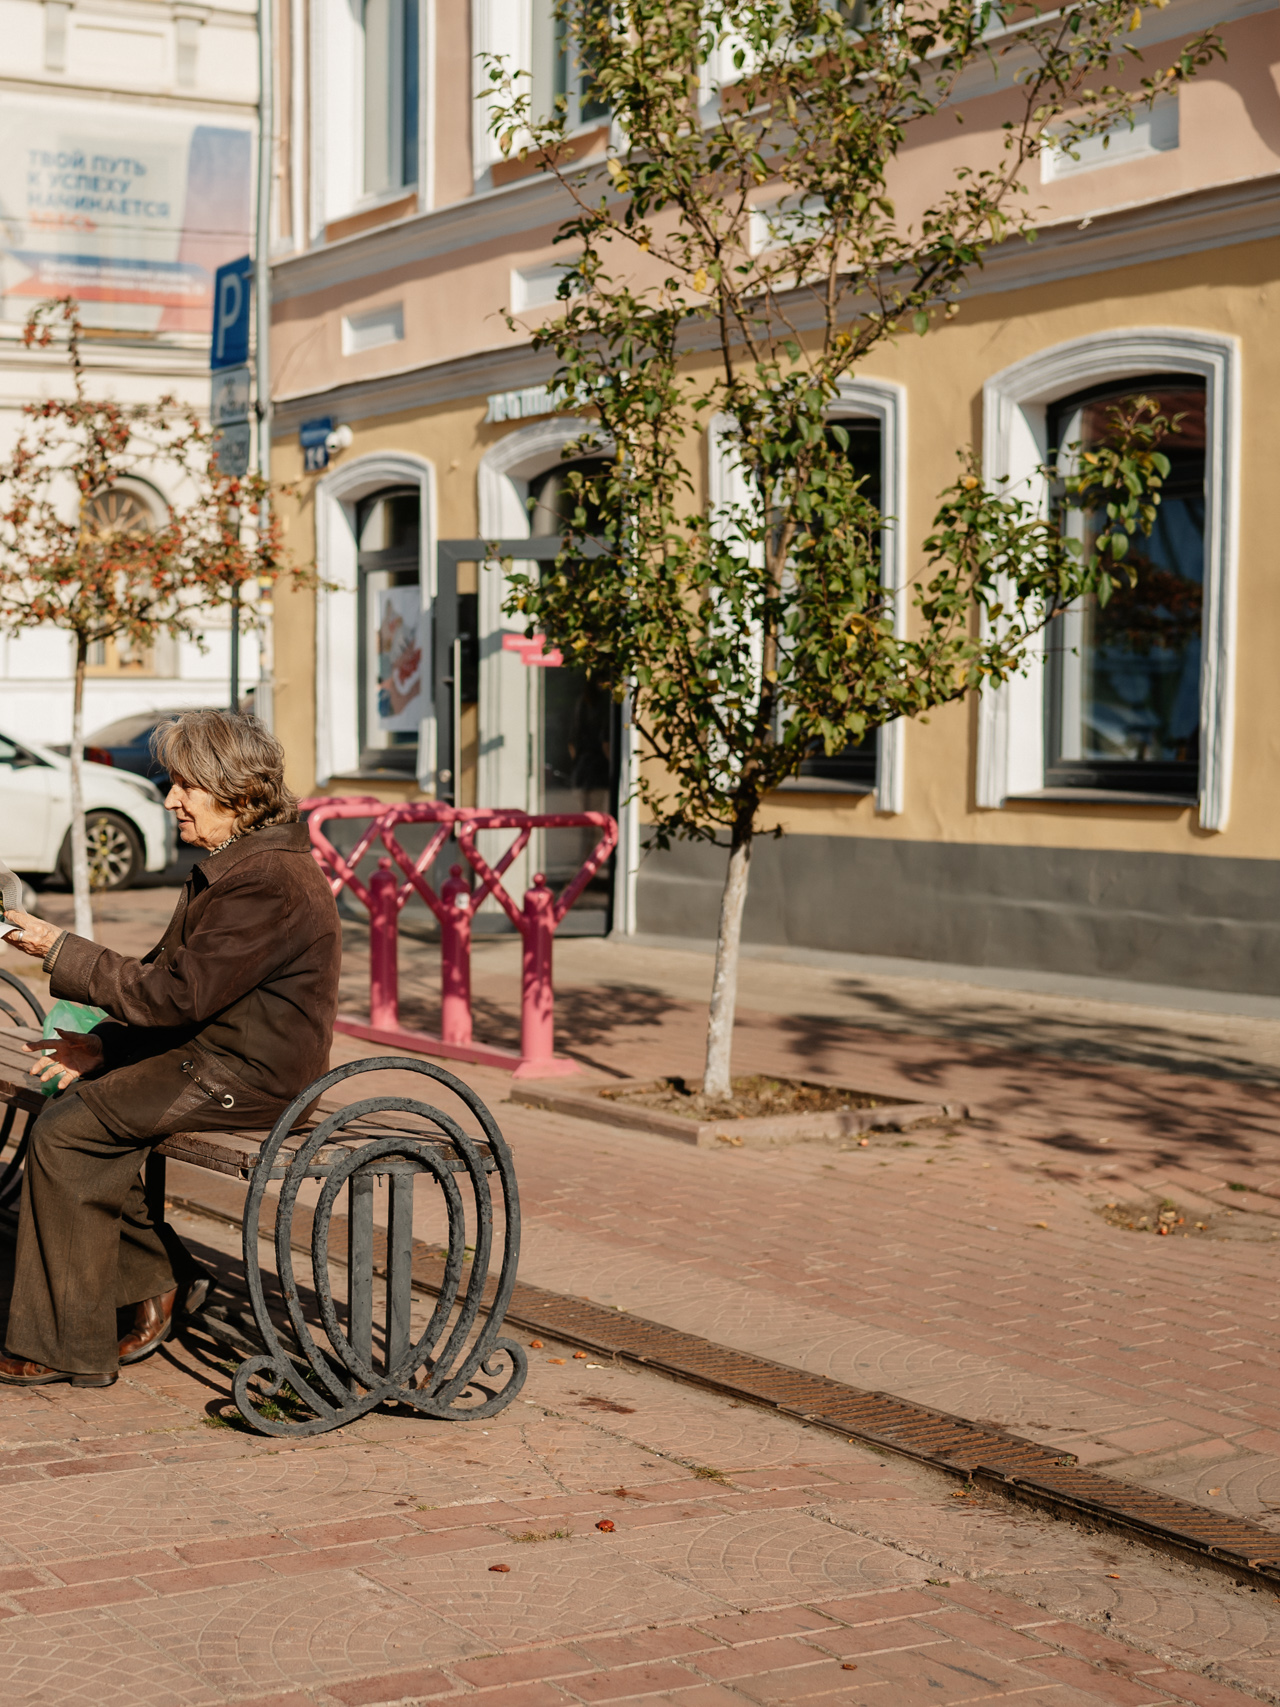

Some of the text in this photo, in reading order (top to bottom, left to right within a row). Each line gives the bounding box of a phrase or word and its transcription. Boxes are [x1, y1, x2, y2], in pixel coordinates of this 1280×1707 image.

[28, 149, 147, 177] ТВОЙ ПУТЬ
[27, 171, 132, 195] К УСПЕХУ
[27, 191, 170, 219] НАЧИНАЕТСЯ
[216, 272, 243, 359] P
